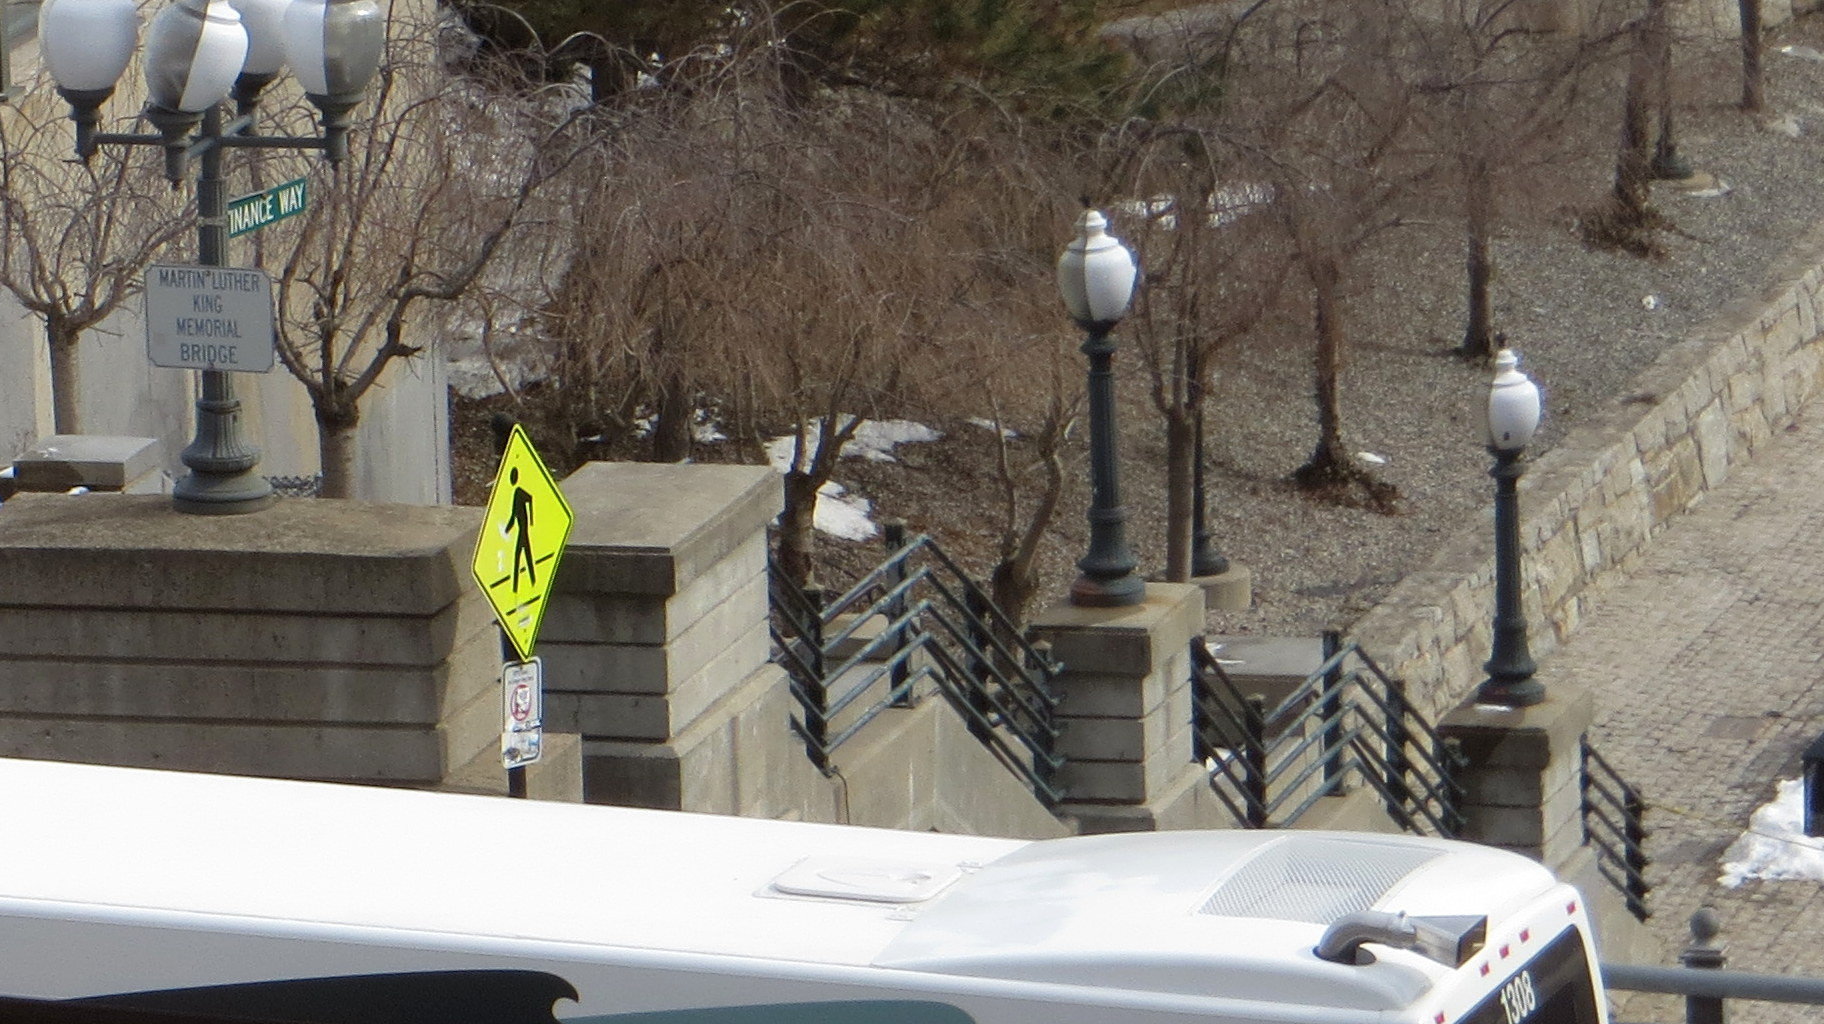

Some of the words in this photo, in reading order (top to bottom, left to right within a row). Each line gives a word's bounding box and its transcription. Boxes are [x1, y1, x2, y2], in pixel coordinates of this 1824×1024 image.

[278, 182, 304, 215] WAY
[159, 268, 205, 289] MARTIN
[212, 272, 260, 292] LUTHER
[192, 294, 223, 314] KING
[176, 317, 242, 339] MEMORIAL
[180, 343, 238, 364] BRIDGE
